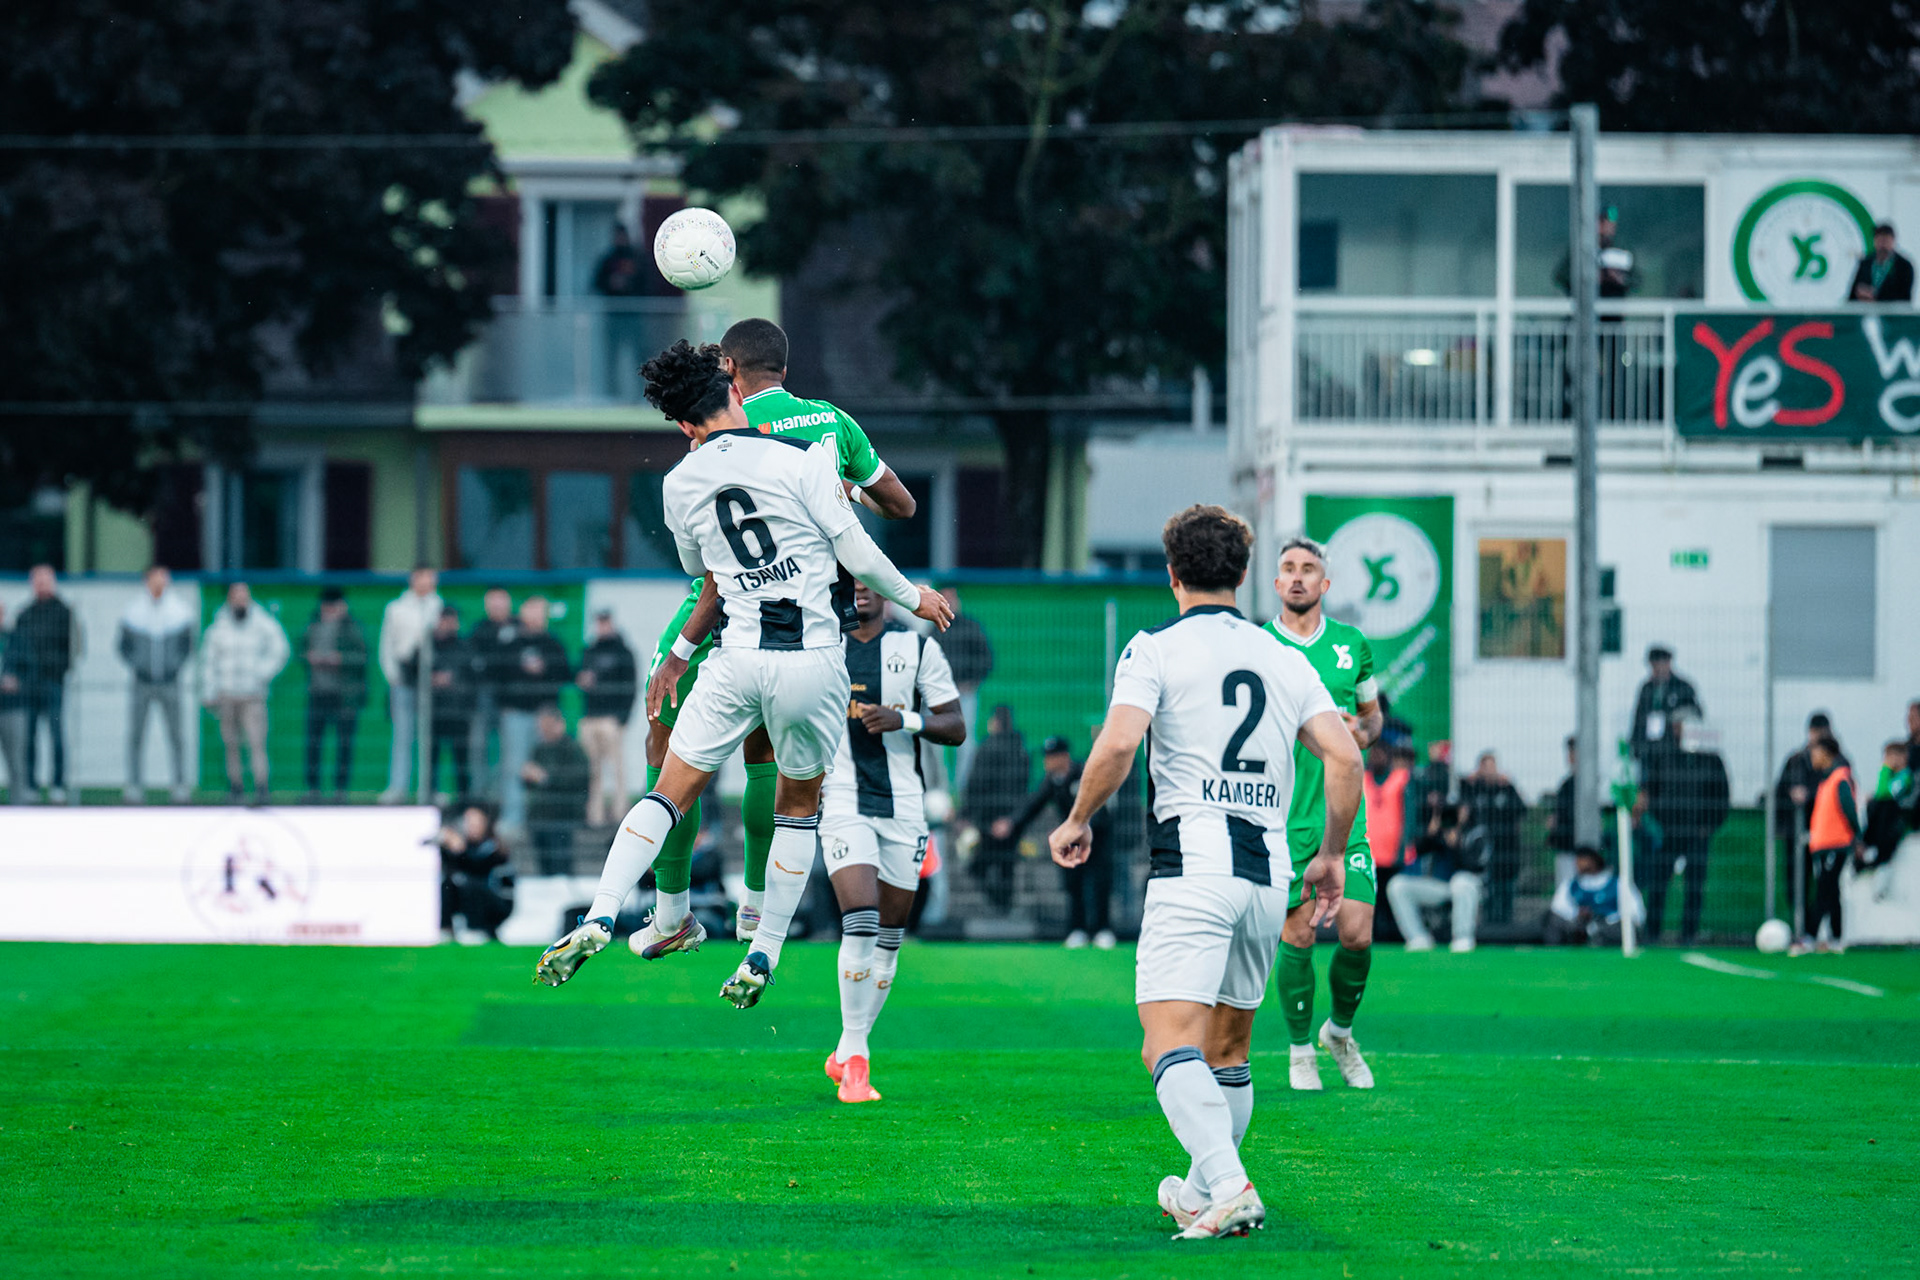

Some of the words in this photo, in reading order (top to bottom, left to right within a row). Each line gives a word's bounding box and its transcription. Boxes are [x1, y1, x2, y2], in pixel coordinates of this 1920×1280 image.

[715, 487, 778, 570] 6
[733, 556, 802, 591] TSAWA
[1221, 669, 1267, 774] 2
